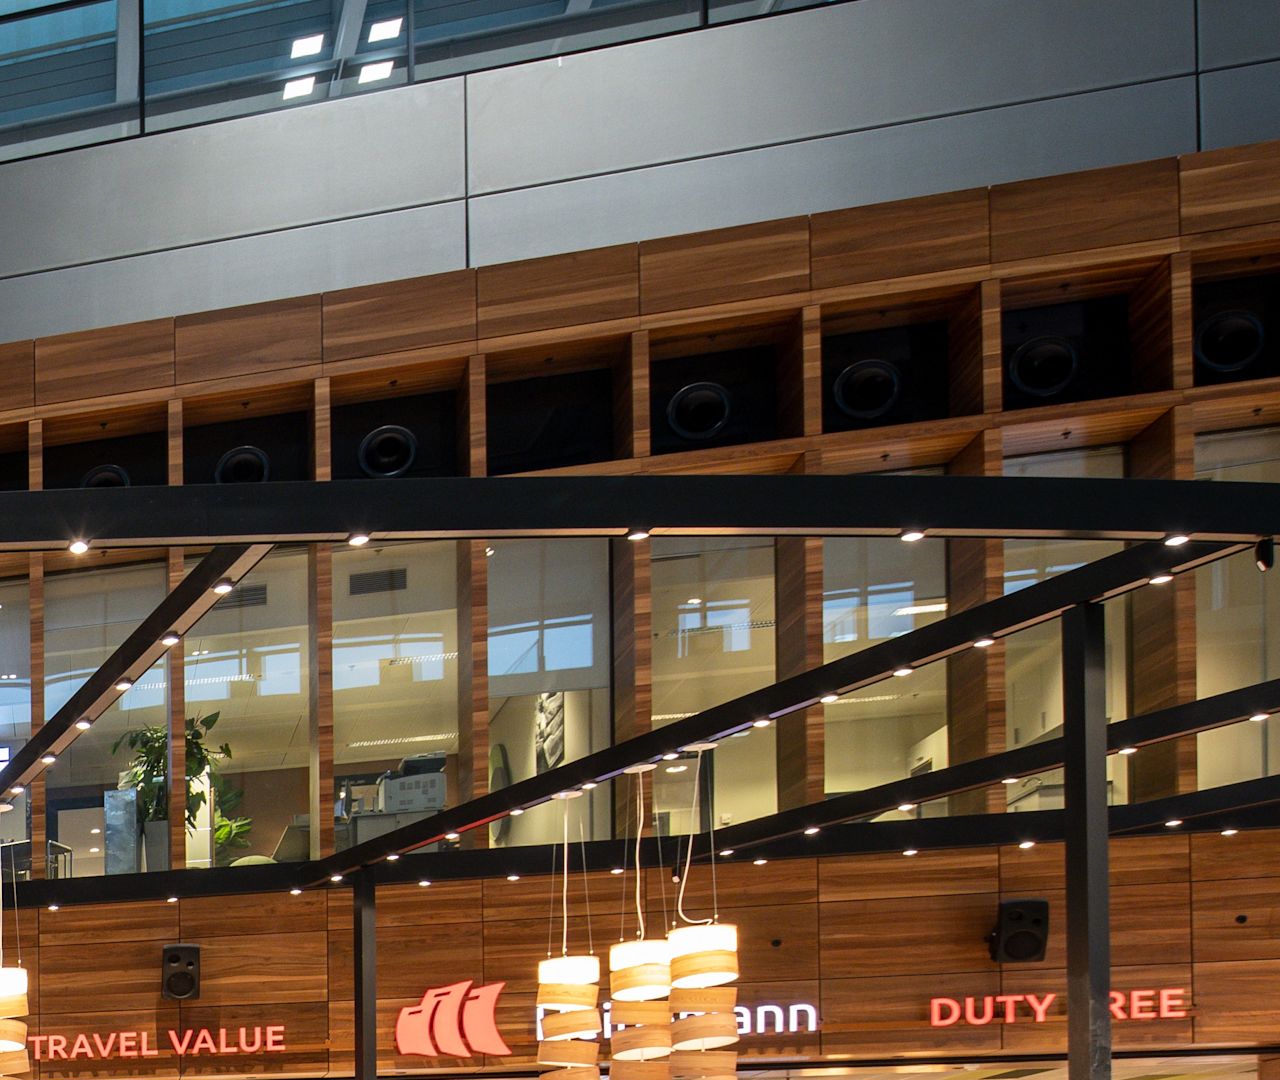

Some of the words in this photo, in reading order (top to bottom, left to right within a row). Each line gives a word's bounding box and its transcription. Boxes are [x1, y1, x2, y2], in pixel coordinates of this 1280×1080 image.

[930, 993, 1057, 1027] DUTY
[1108, 988, 1187, 1020] REE
[27, 1031, 159, 1060] TRAVEL
[168, 1025, 286, 1055] VALUE
